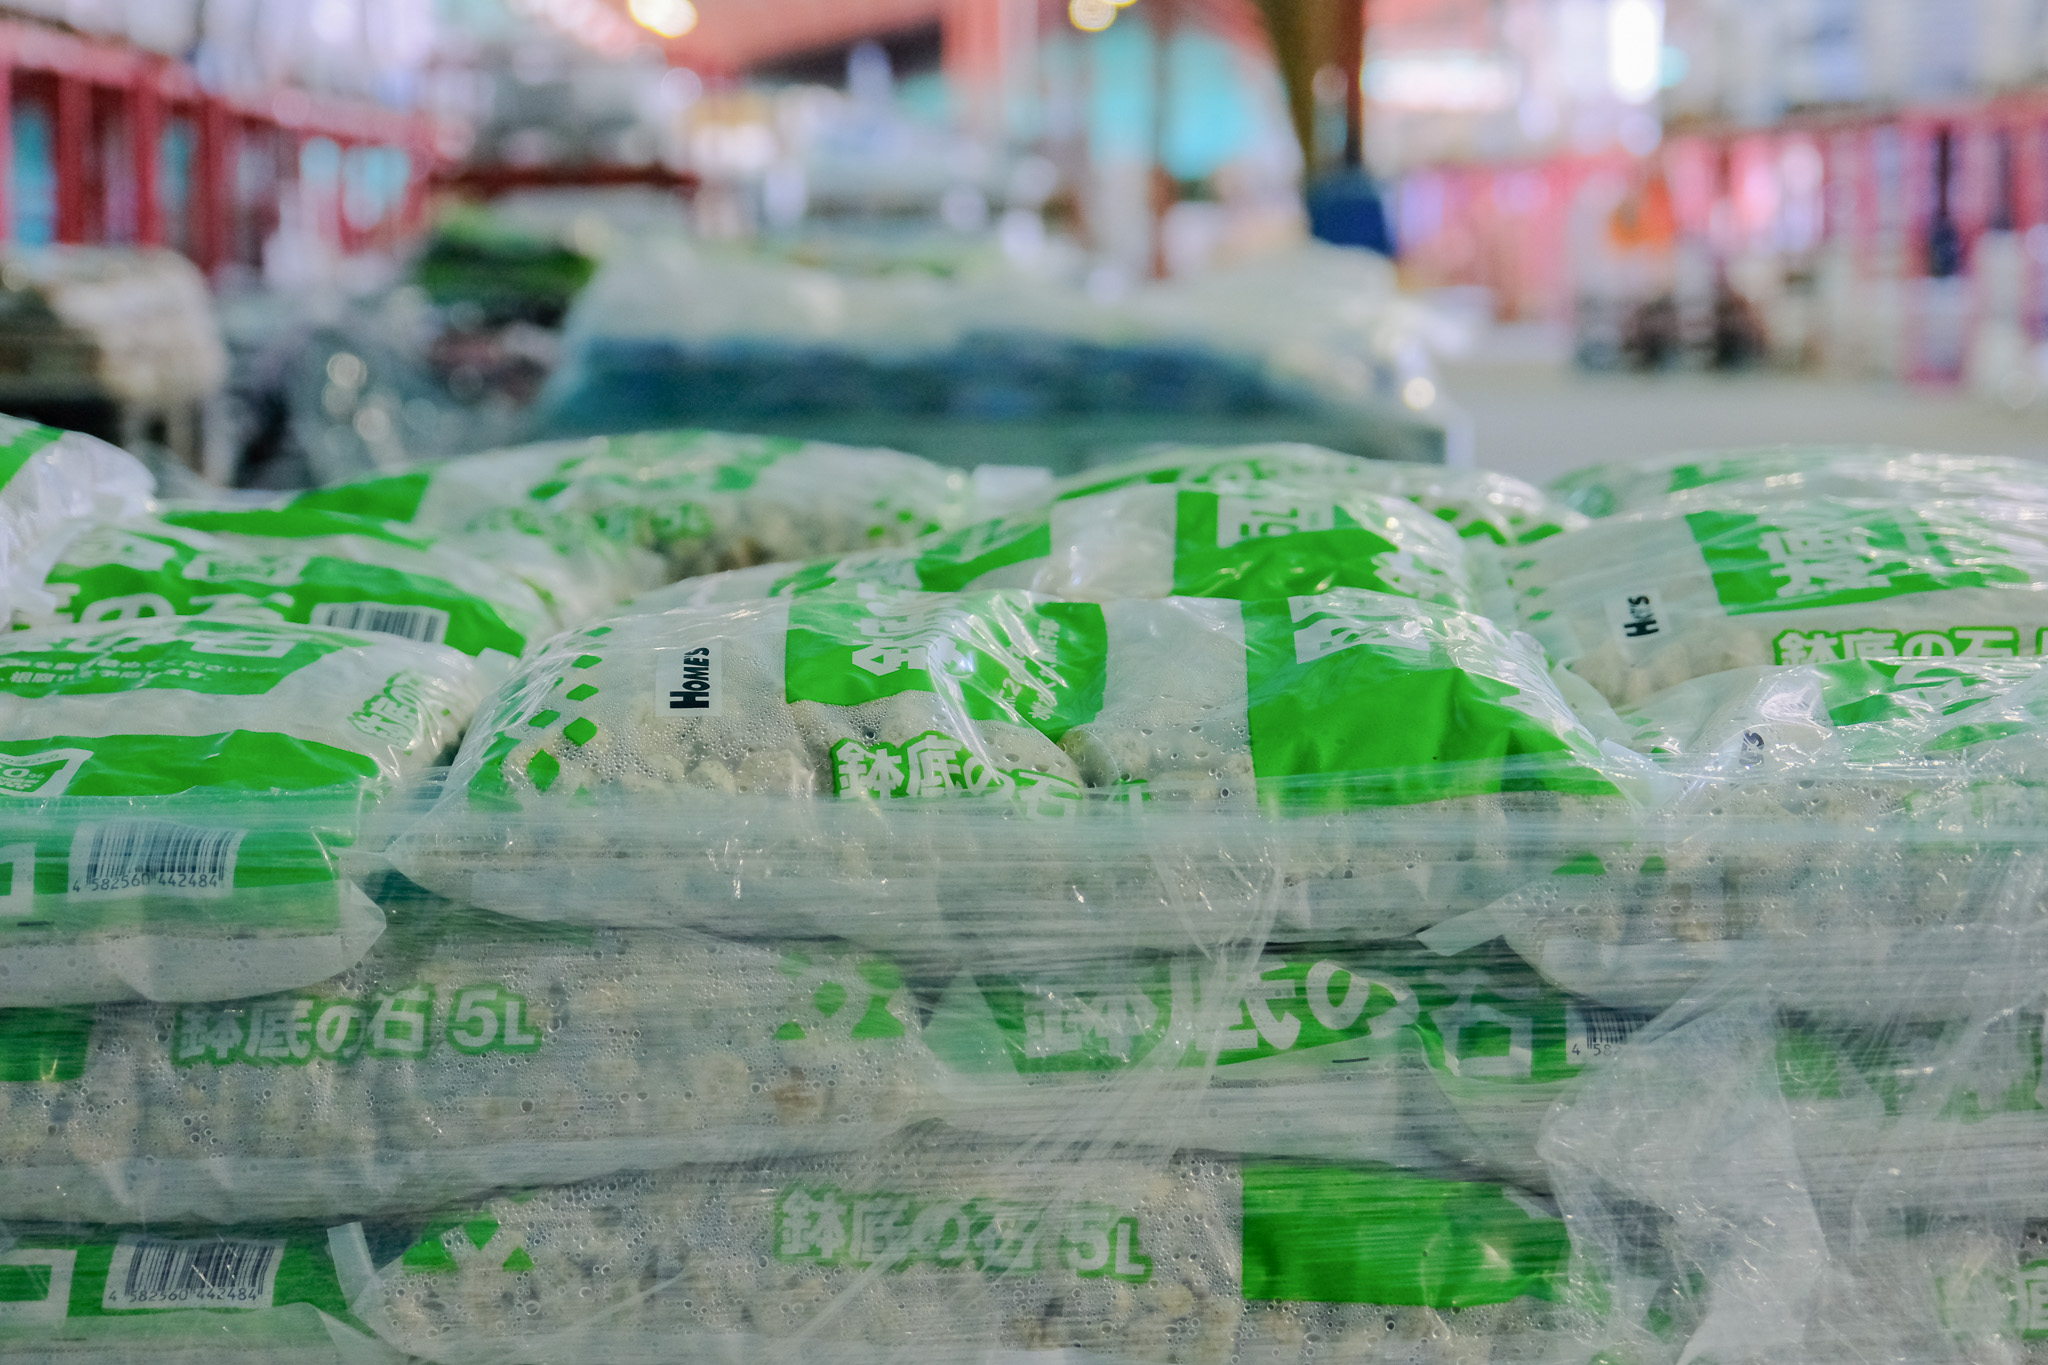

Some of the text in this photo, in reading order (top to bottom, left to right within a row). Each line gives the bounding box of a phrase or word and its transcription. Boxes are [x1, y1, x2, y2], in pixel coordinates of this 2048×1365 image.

[91, 873, 150, 891] 582560
[158, 873, 218, 888] 442484
[452, 988, 537, 1047] 5L
[1072, 1208, 1146, 1275] 5L
[130, 1288, 189, 1303] 582560
[196, 1287, 257, 1300] 442484
